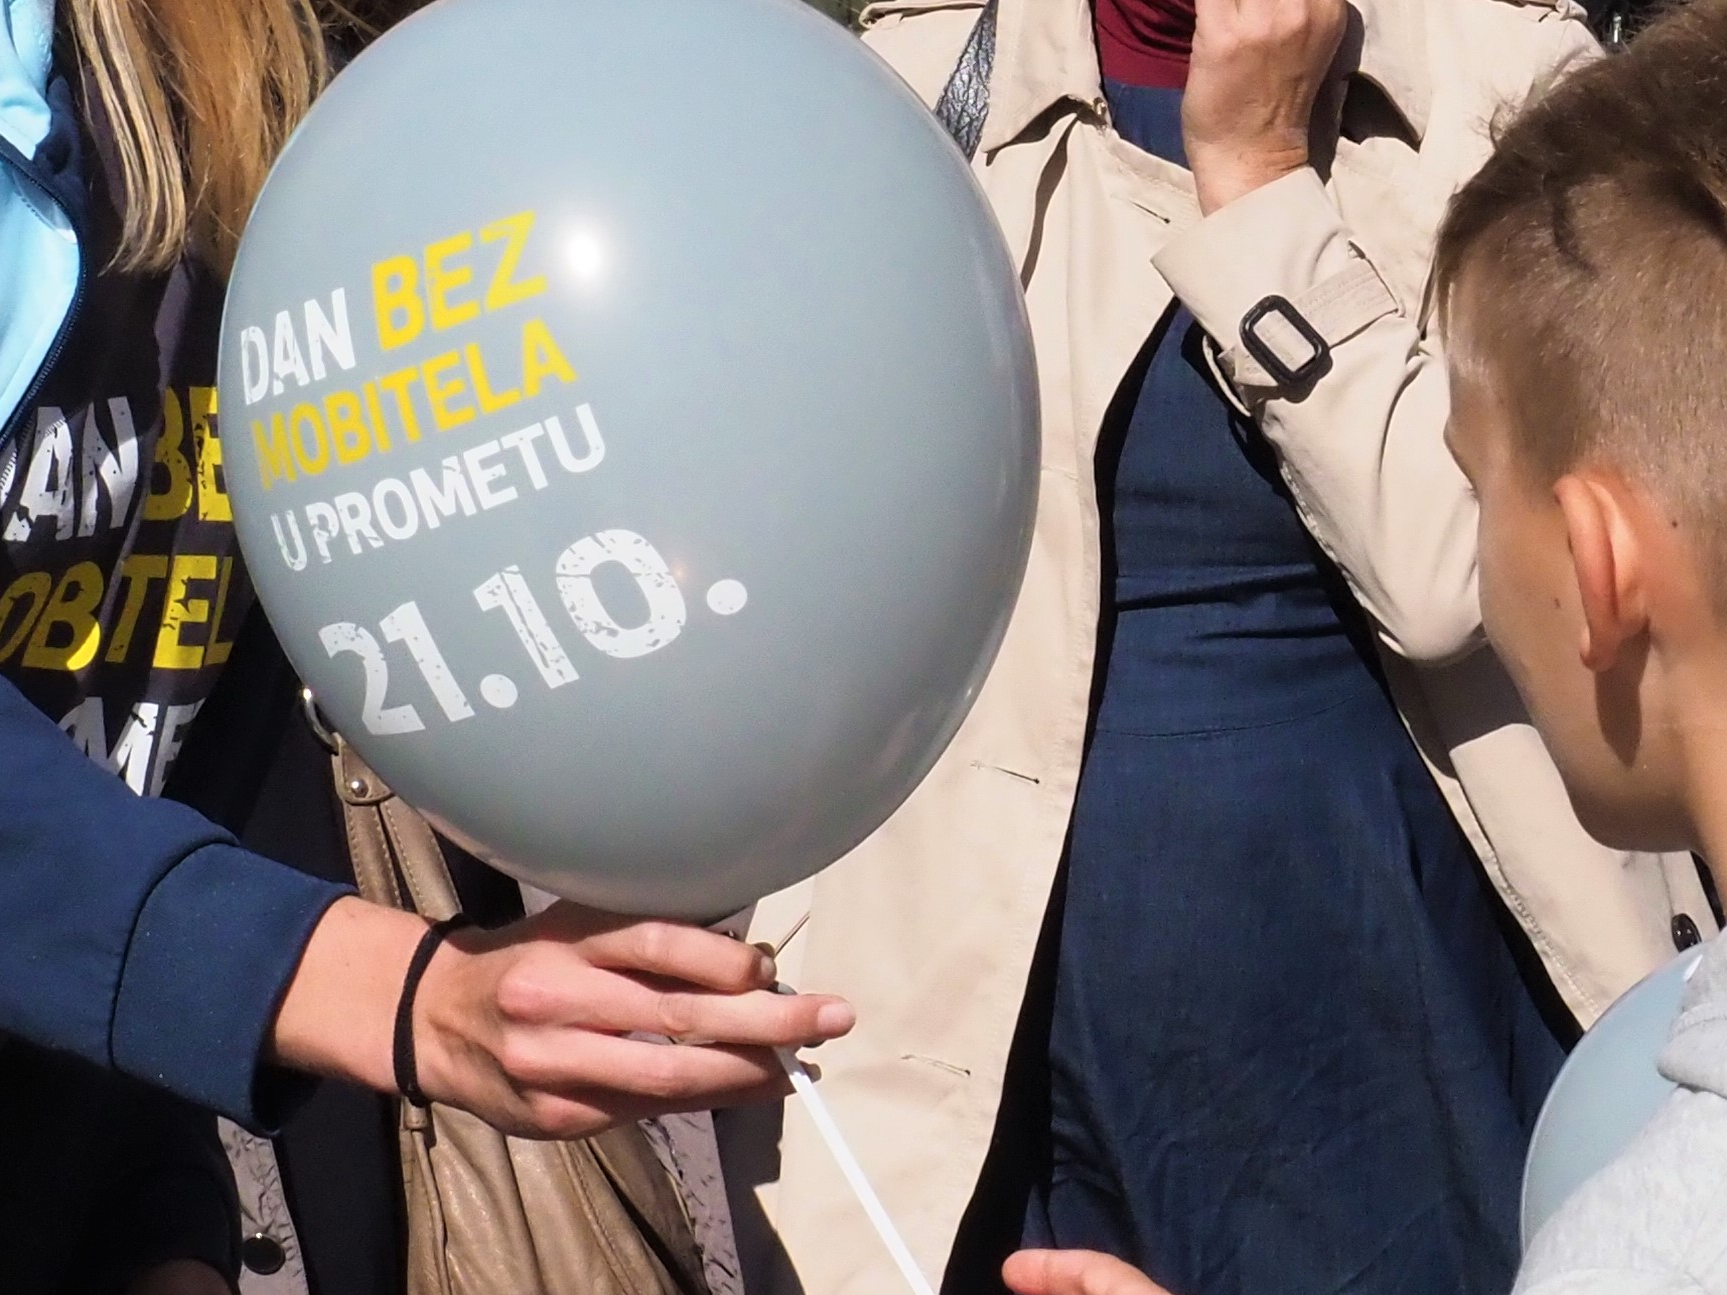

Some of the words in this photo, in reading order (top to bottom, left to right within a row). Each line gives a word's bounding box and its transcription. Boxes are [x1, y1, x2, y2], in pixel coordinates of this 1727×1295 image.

[241, 289, 356, 406] DAN
[371, 210, 548, 351] BEZ
[250, 319, 579, 491] MOBITELA
[269, 510, 307, 572] U
[309, 403, 608, 567] PROMETU
[317, 527, 750, 736] 21.10.
